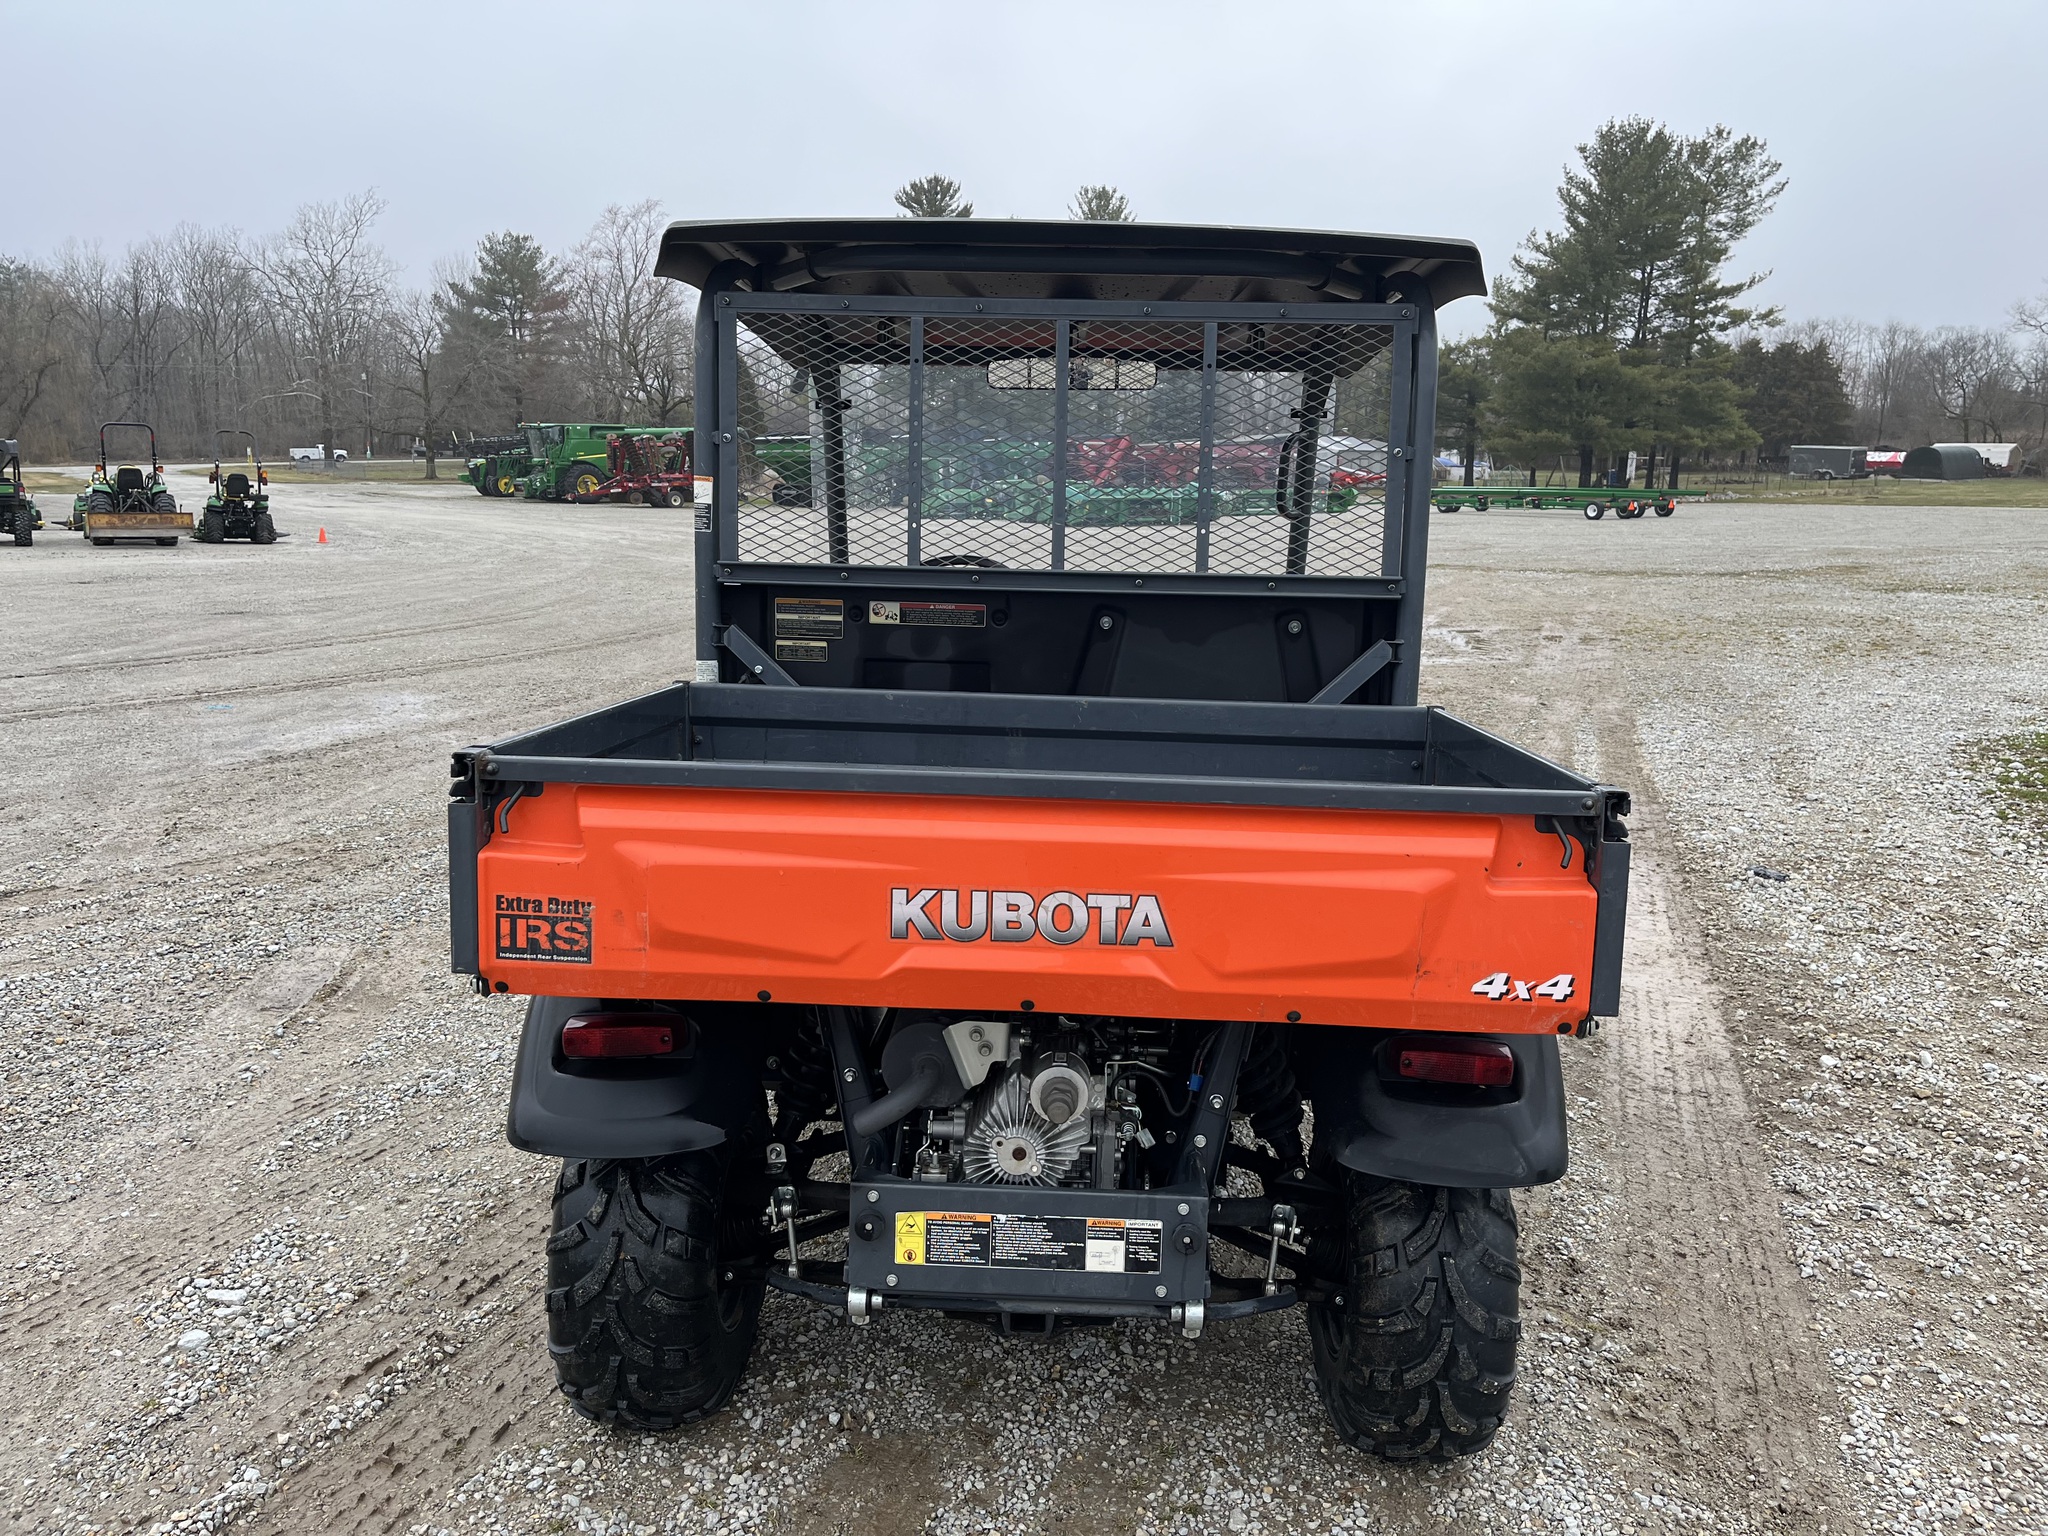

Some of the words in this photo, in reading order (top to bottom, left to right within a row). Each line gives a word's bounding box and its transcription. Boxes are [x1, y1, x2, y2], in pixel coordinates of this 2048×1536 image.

[496, 895, 543, 914] Extra
[548, 897, 593, 917] Duty
[890, 888, 1174, 947] KUBOTA
[500, 917, 589, 952] IRS
[499, 952, 537, 960] Independent
[552, 954, 588, 962] Suspension
[1470, 972, 1575, 1002] 4x4
